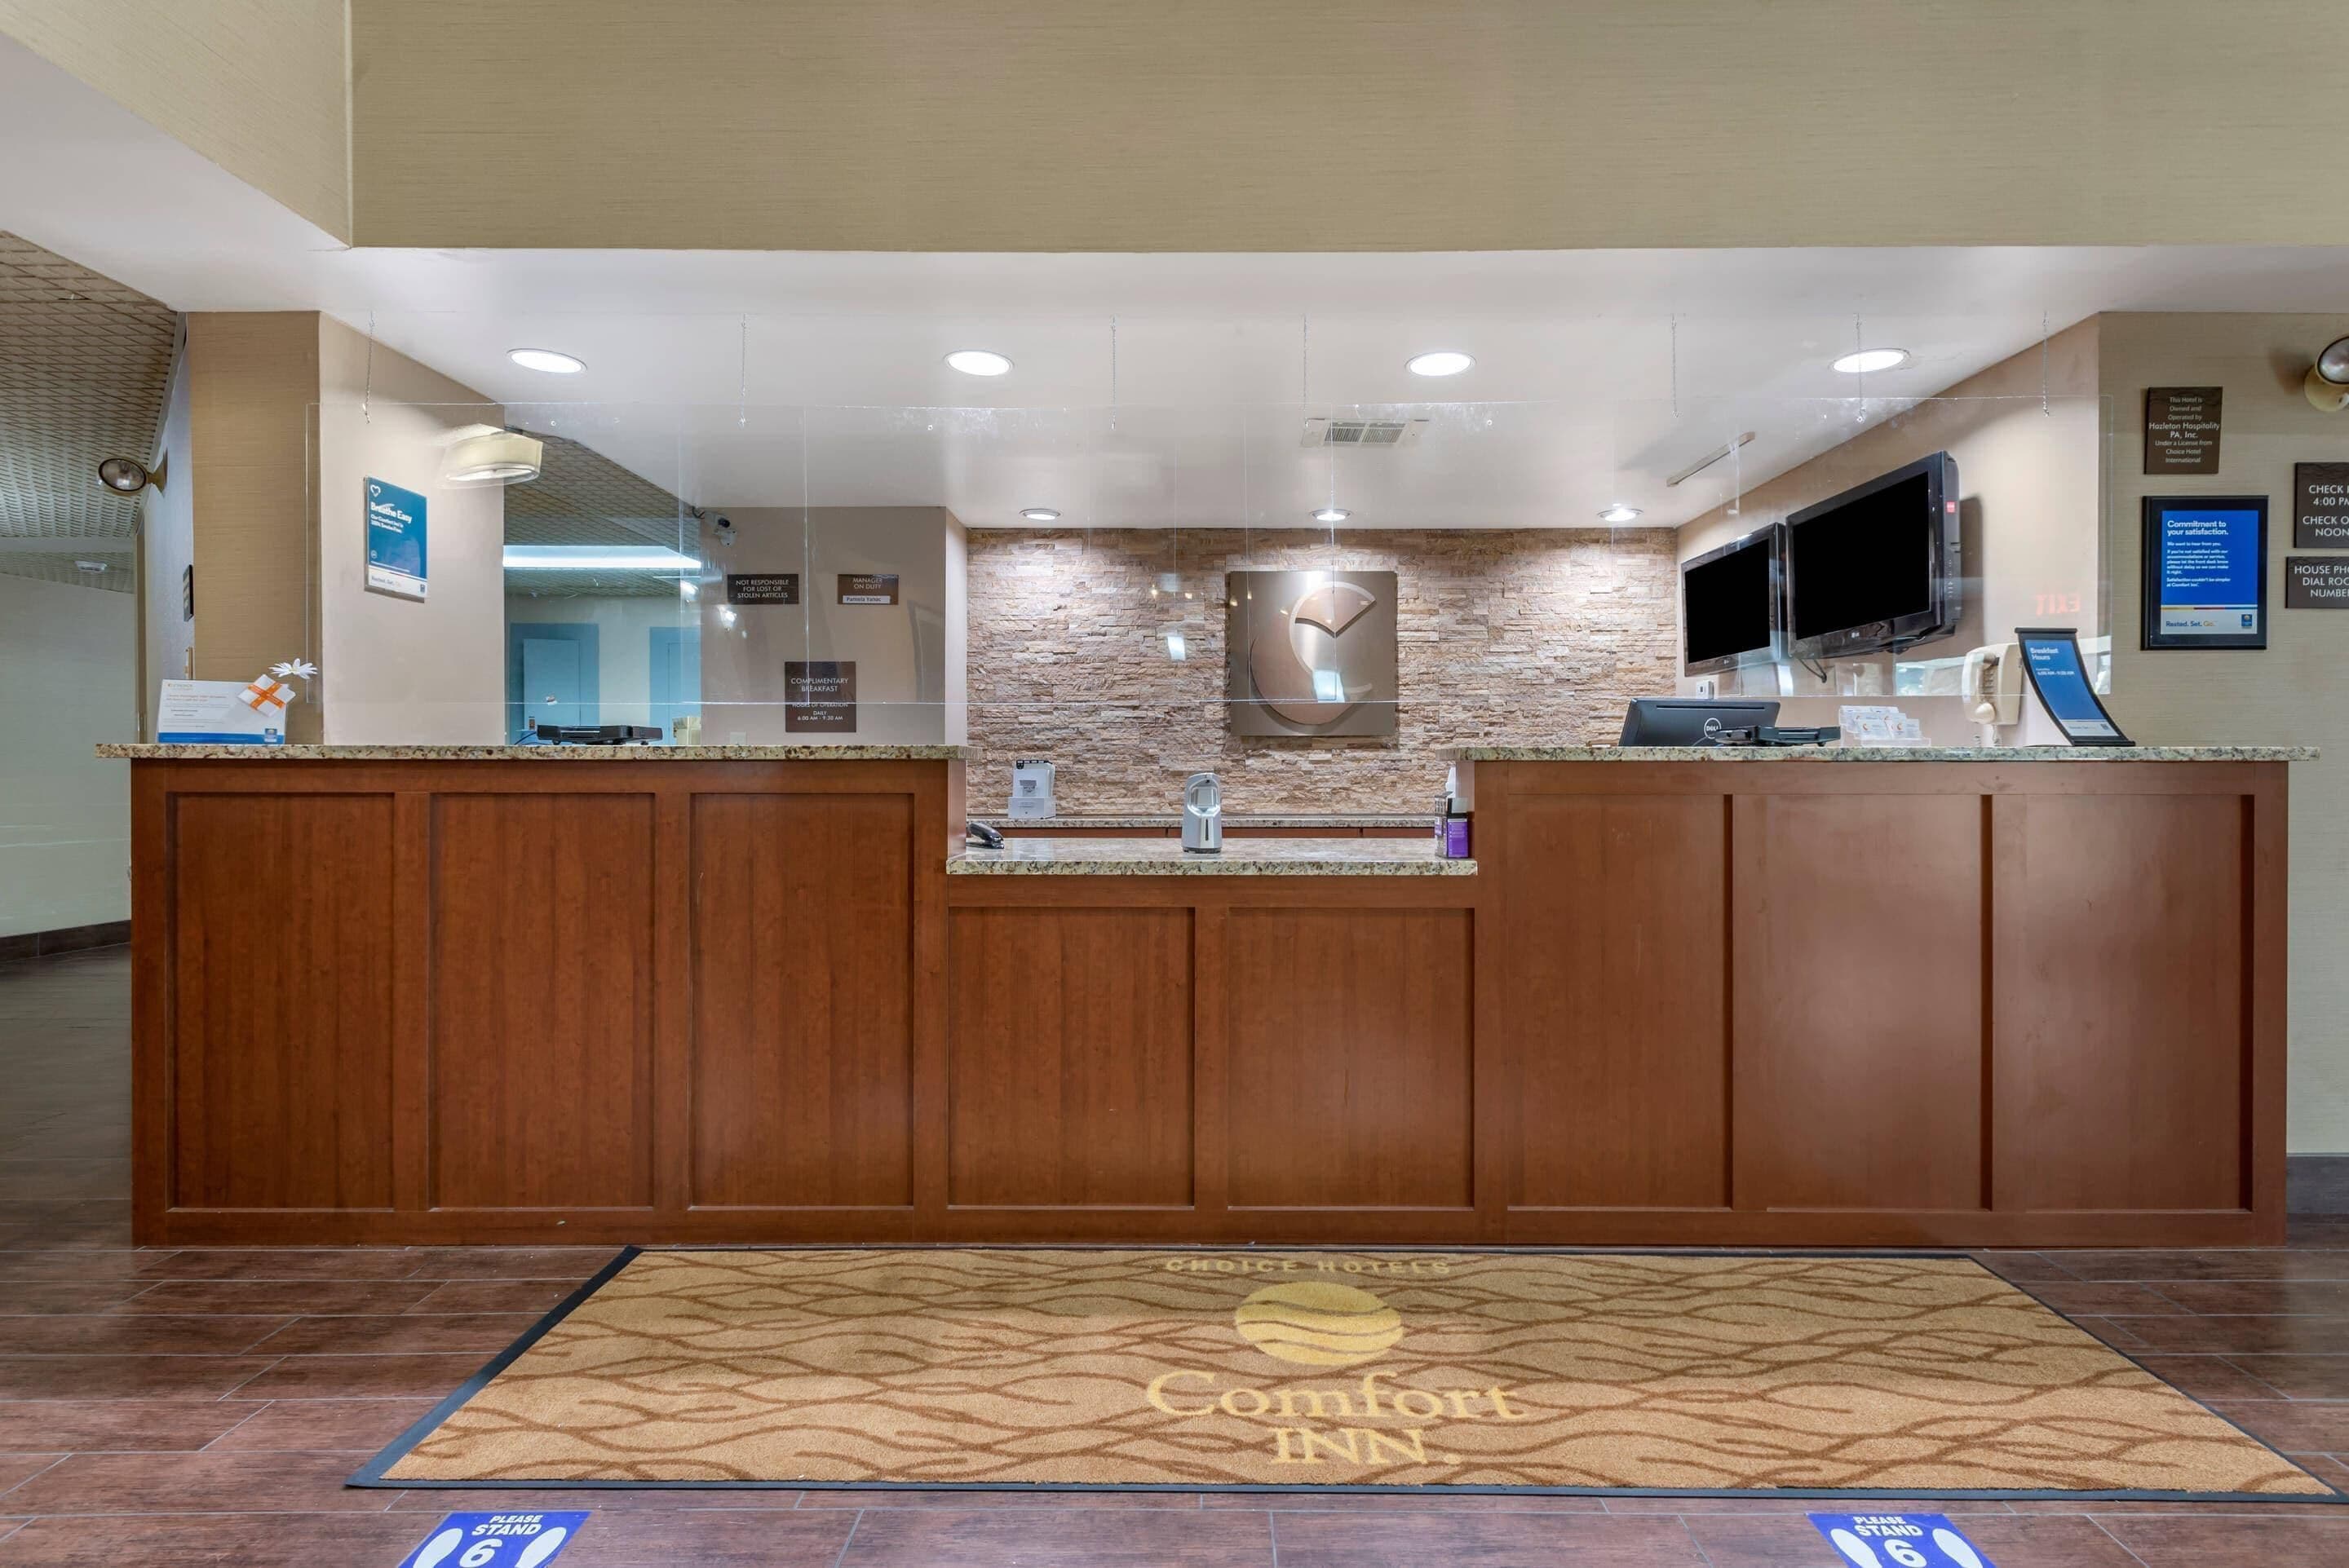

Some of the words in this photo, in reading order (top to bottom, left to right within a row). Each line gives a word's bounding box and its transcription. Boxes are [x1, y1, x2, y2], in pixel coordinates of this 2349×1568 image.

[2309, 485, 2343, 494] CHECK
[2313, 497, 2335, 506] 4:00
[2303, 516, 2337, 524] CHECK
[2315, 528, 2349, 536] NOON
[2295, 565, 2330, 574] HOUSE
[2303, 577, 2325, 586] DIAL
[2328, 577, 2349, 586] ROO
[2310, 589, 2349, 597] NUMBE
[1164, 1259, 1300, 1272] CHOICE
[1317, 1260, 1451, 1274] HOTELS
[1146, 1370, 1529, 1420] Comfort
[489, 1515, 543, 1523] PLEASE
[471, 1524, 542, 1536] STAND
[1854, 1525, 1924, 1536] STAND
[459, 1538, 503, 1567] 6
[1884, 1539, 1927, 1567] 6
